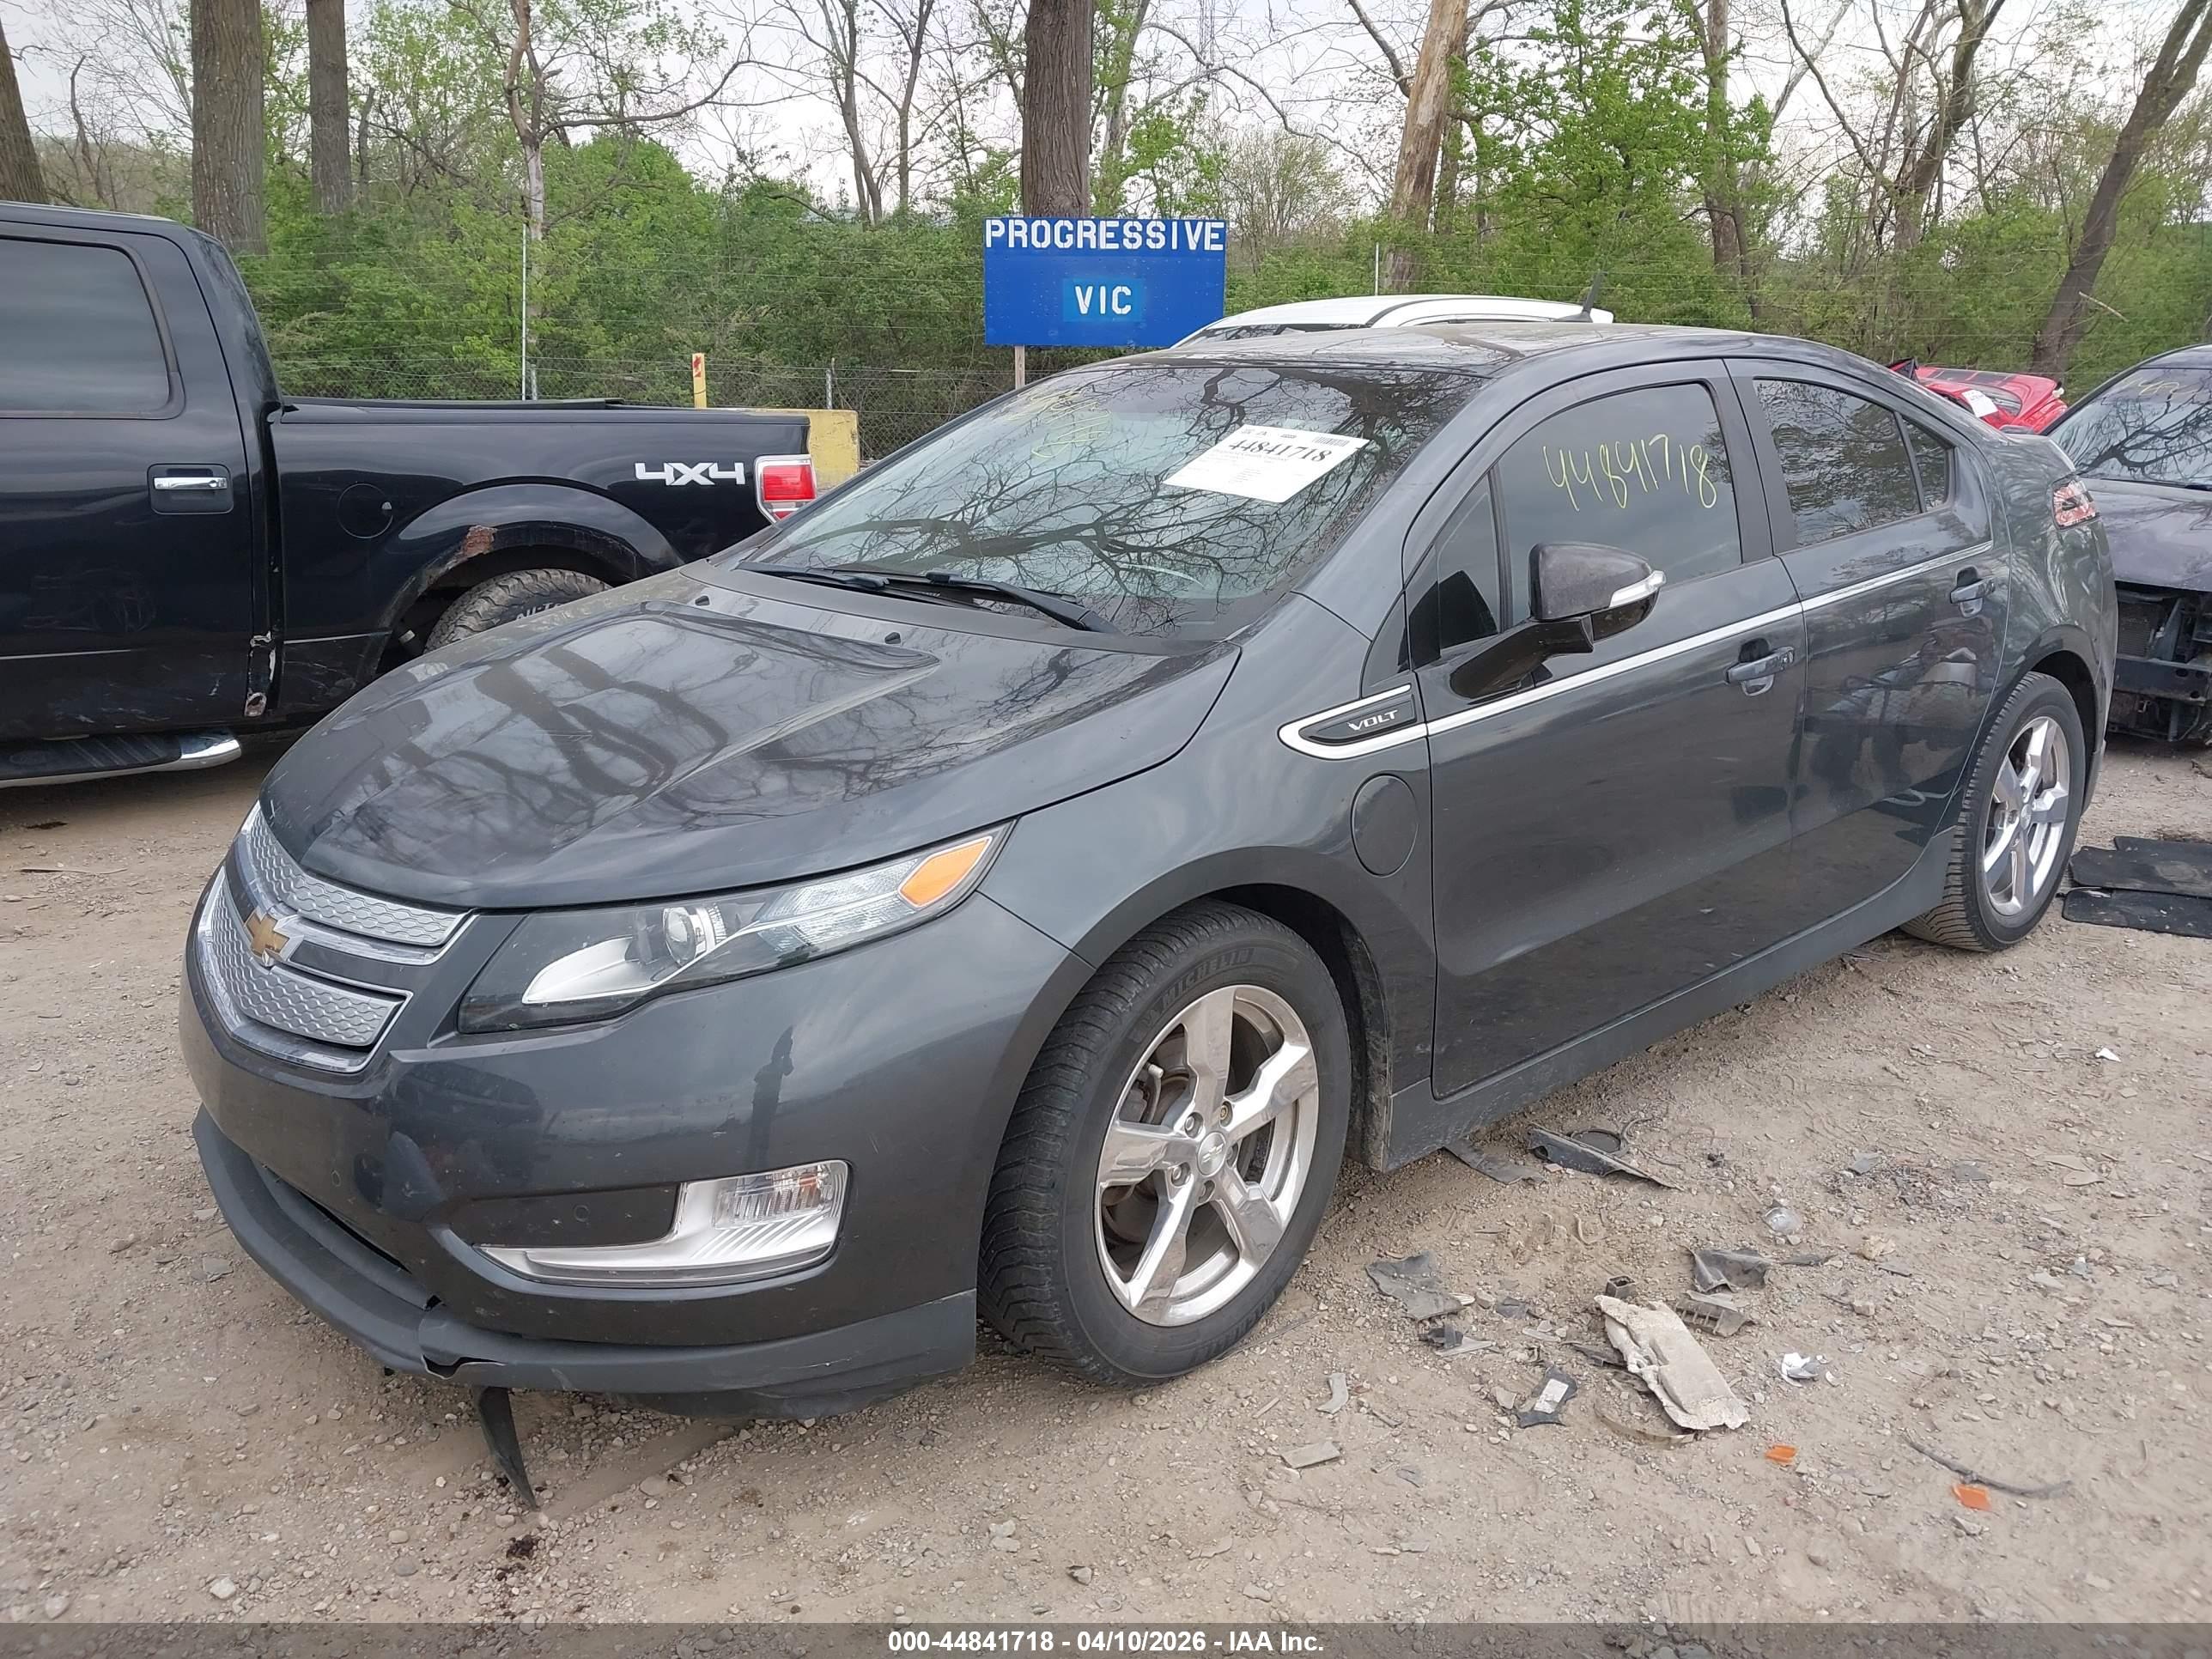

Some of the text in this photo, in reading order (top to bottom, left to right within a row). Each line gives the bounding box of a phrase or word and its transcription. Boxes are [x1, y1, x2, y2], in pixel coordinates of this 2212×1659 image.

[985, 219, 1225, 251] PROGRESSIVE
[1075, 285, 1132, 315] VIC
[1229, 439, 1332, 462] 44841718
[1543, 434, 1717, 512] 44841718
[1346, 709, 1398, 731] VOLT
[1162, 947, 1255, 1006] MICHELIN
